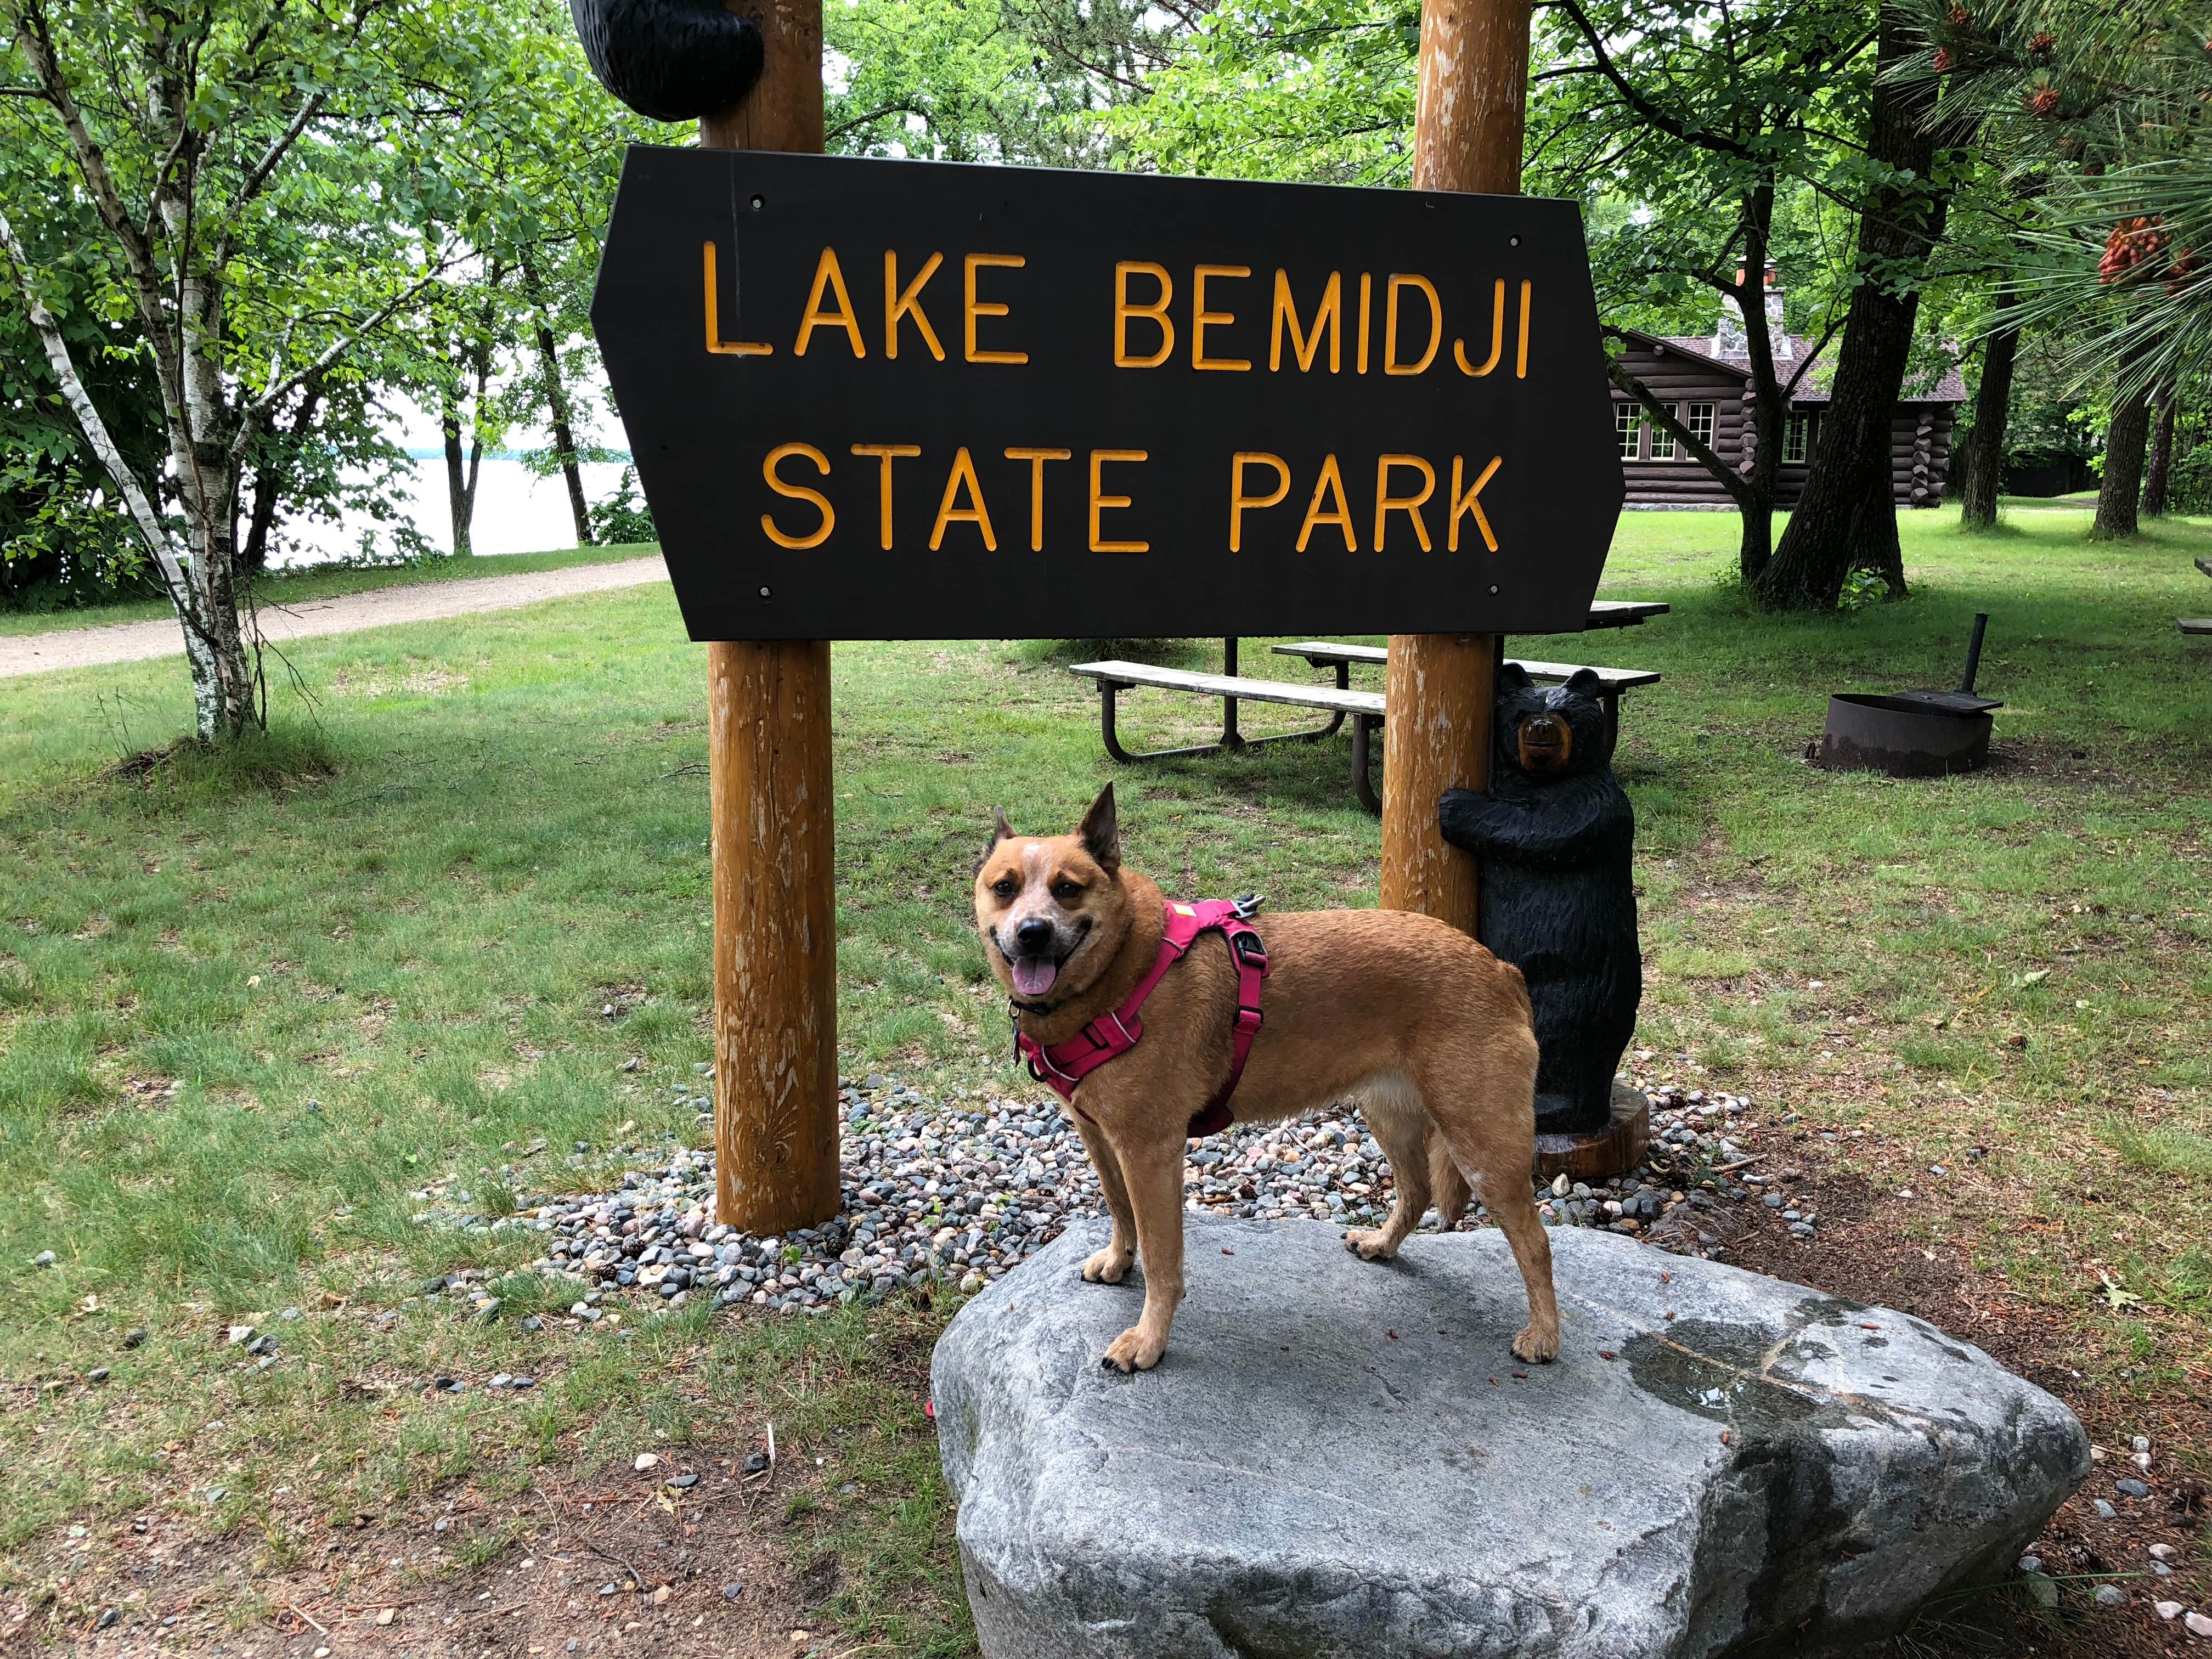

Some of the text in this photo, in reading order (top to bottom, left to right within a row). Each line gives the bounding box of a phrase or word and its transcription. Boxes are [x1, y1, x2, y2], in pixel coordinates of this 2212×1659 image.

[703, 240, 1532, 380] LAKE BEMIDJI
[760, 442, 1503, 554] STATE PARK
